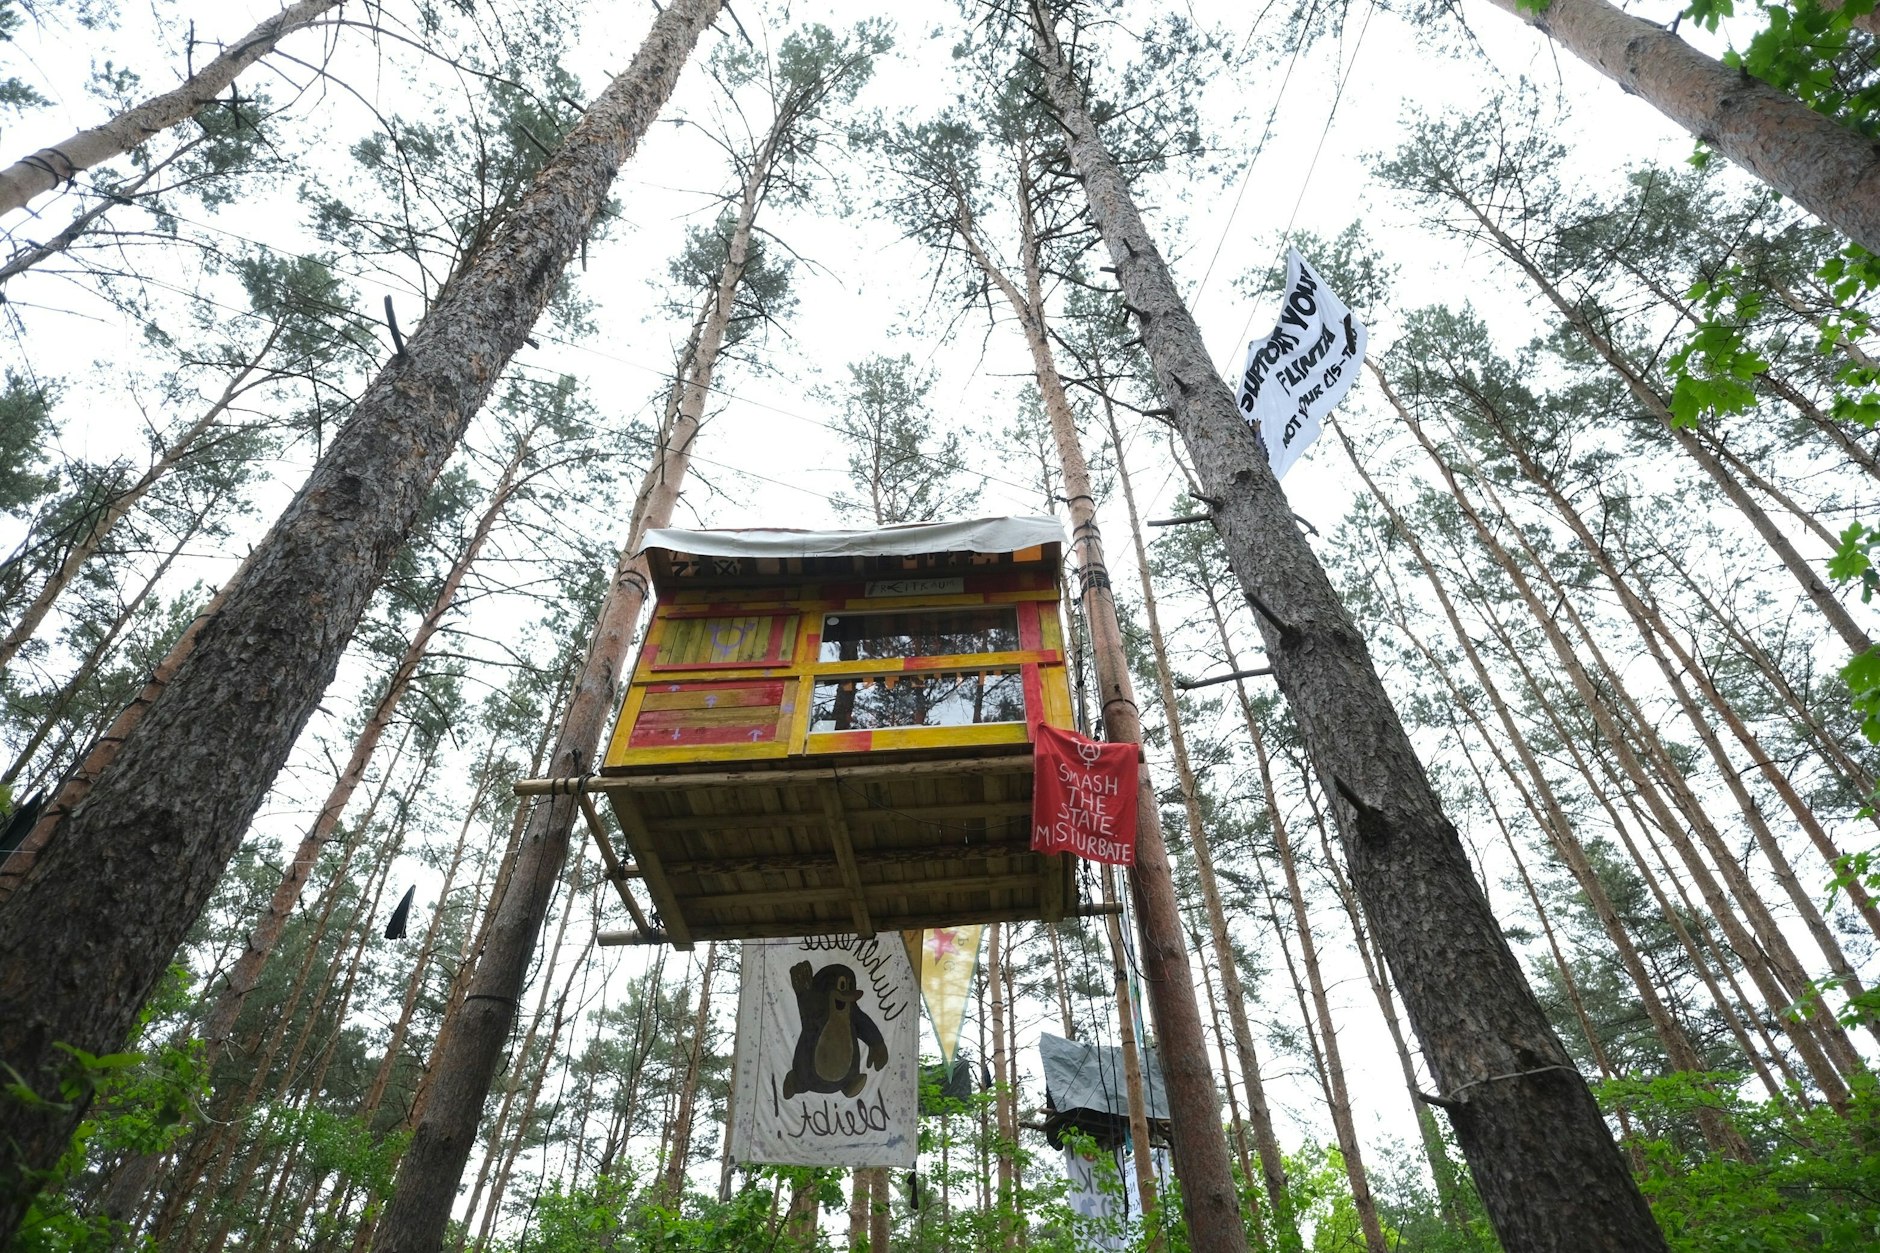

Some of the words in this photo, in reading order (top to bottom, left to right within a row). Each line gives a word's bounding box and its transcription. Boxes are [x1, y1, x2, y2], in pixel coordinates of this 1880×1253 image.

[1240, 325, 1299, 413] SUPPORT
[1275, 323, 1336, 397] FLINTA
[1282, 415, 1302, 449] NOT
[1298, 383, 1324, 419] YOUR
[1058, 763, 1118, 796] SMASH
[1066, 785, 1106, 815] THE
[1057, 802, 1118, 838] STATE.
